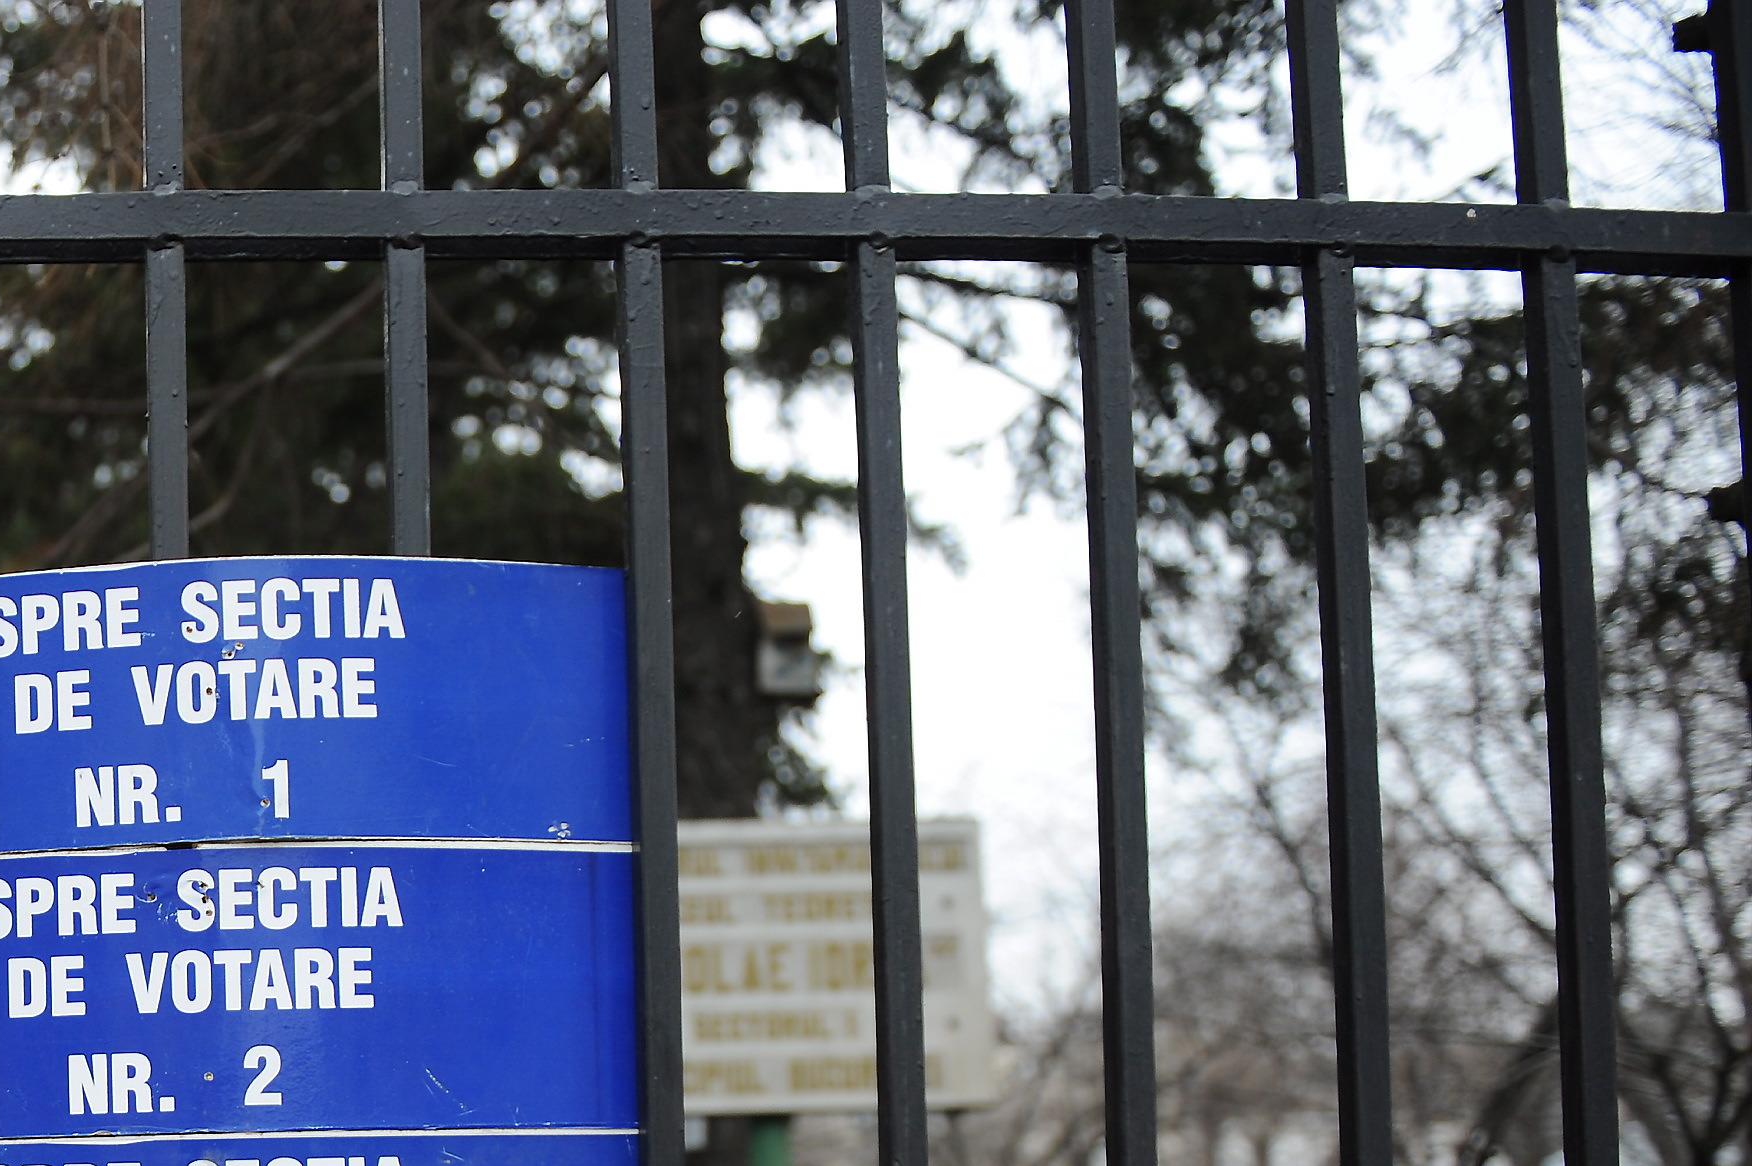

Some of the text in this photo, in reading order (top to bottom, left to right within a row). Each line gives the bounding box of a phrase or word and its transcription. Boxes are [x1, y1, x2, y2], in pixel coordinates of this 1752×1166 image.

[180, 577, 406, 644] SECTIA
[13, 657, 379, 735] DE VOTARE
[74, 759, 291, 828] NR. 1
[174, 866, 405, 933] SECTIA
[6, 947, 376, 1019] DE VOTARE
[67, 1045, 284, 1115] NR. 2
